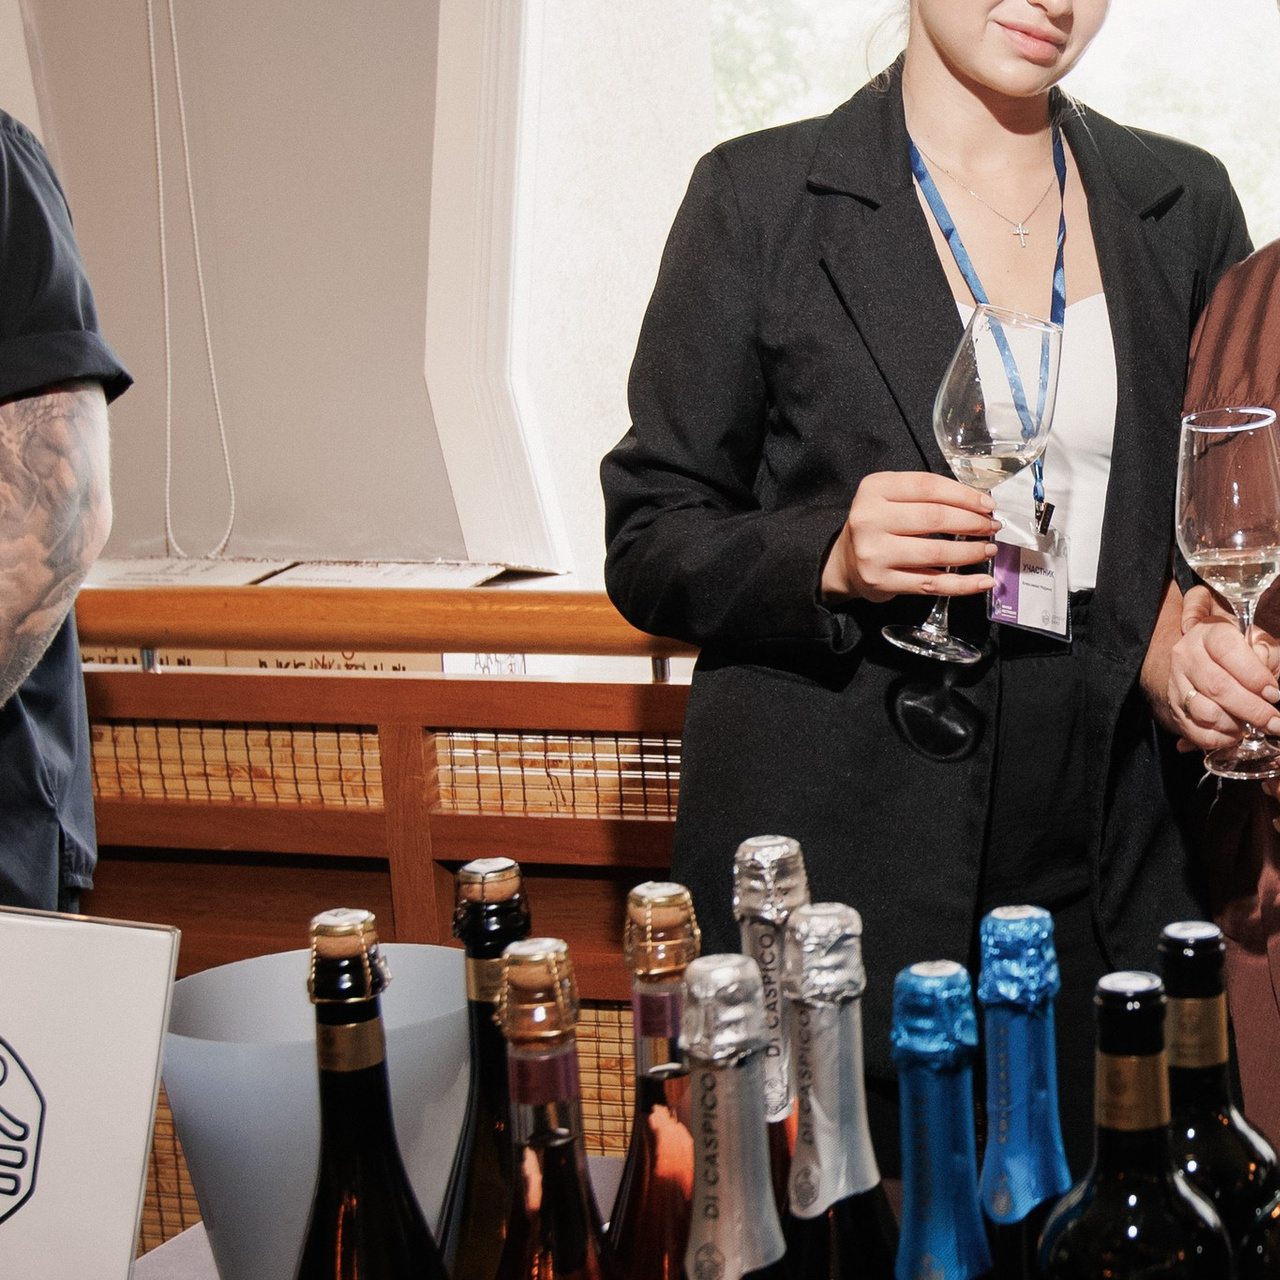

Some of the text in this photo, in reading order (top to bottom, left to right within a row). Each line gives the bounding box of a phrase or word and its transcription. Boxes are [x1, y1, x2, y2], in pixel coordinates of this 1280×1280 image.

[1022, 562, 1055, 579] УЧАСТНИК
[759, 933, 781, 1058] DI CASPICO
[798, 1010, 814, 1115] CASPICO
[700, 1072, 719, 1220] DI CASPICO
